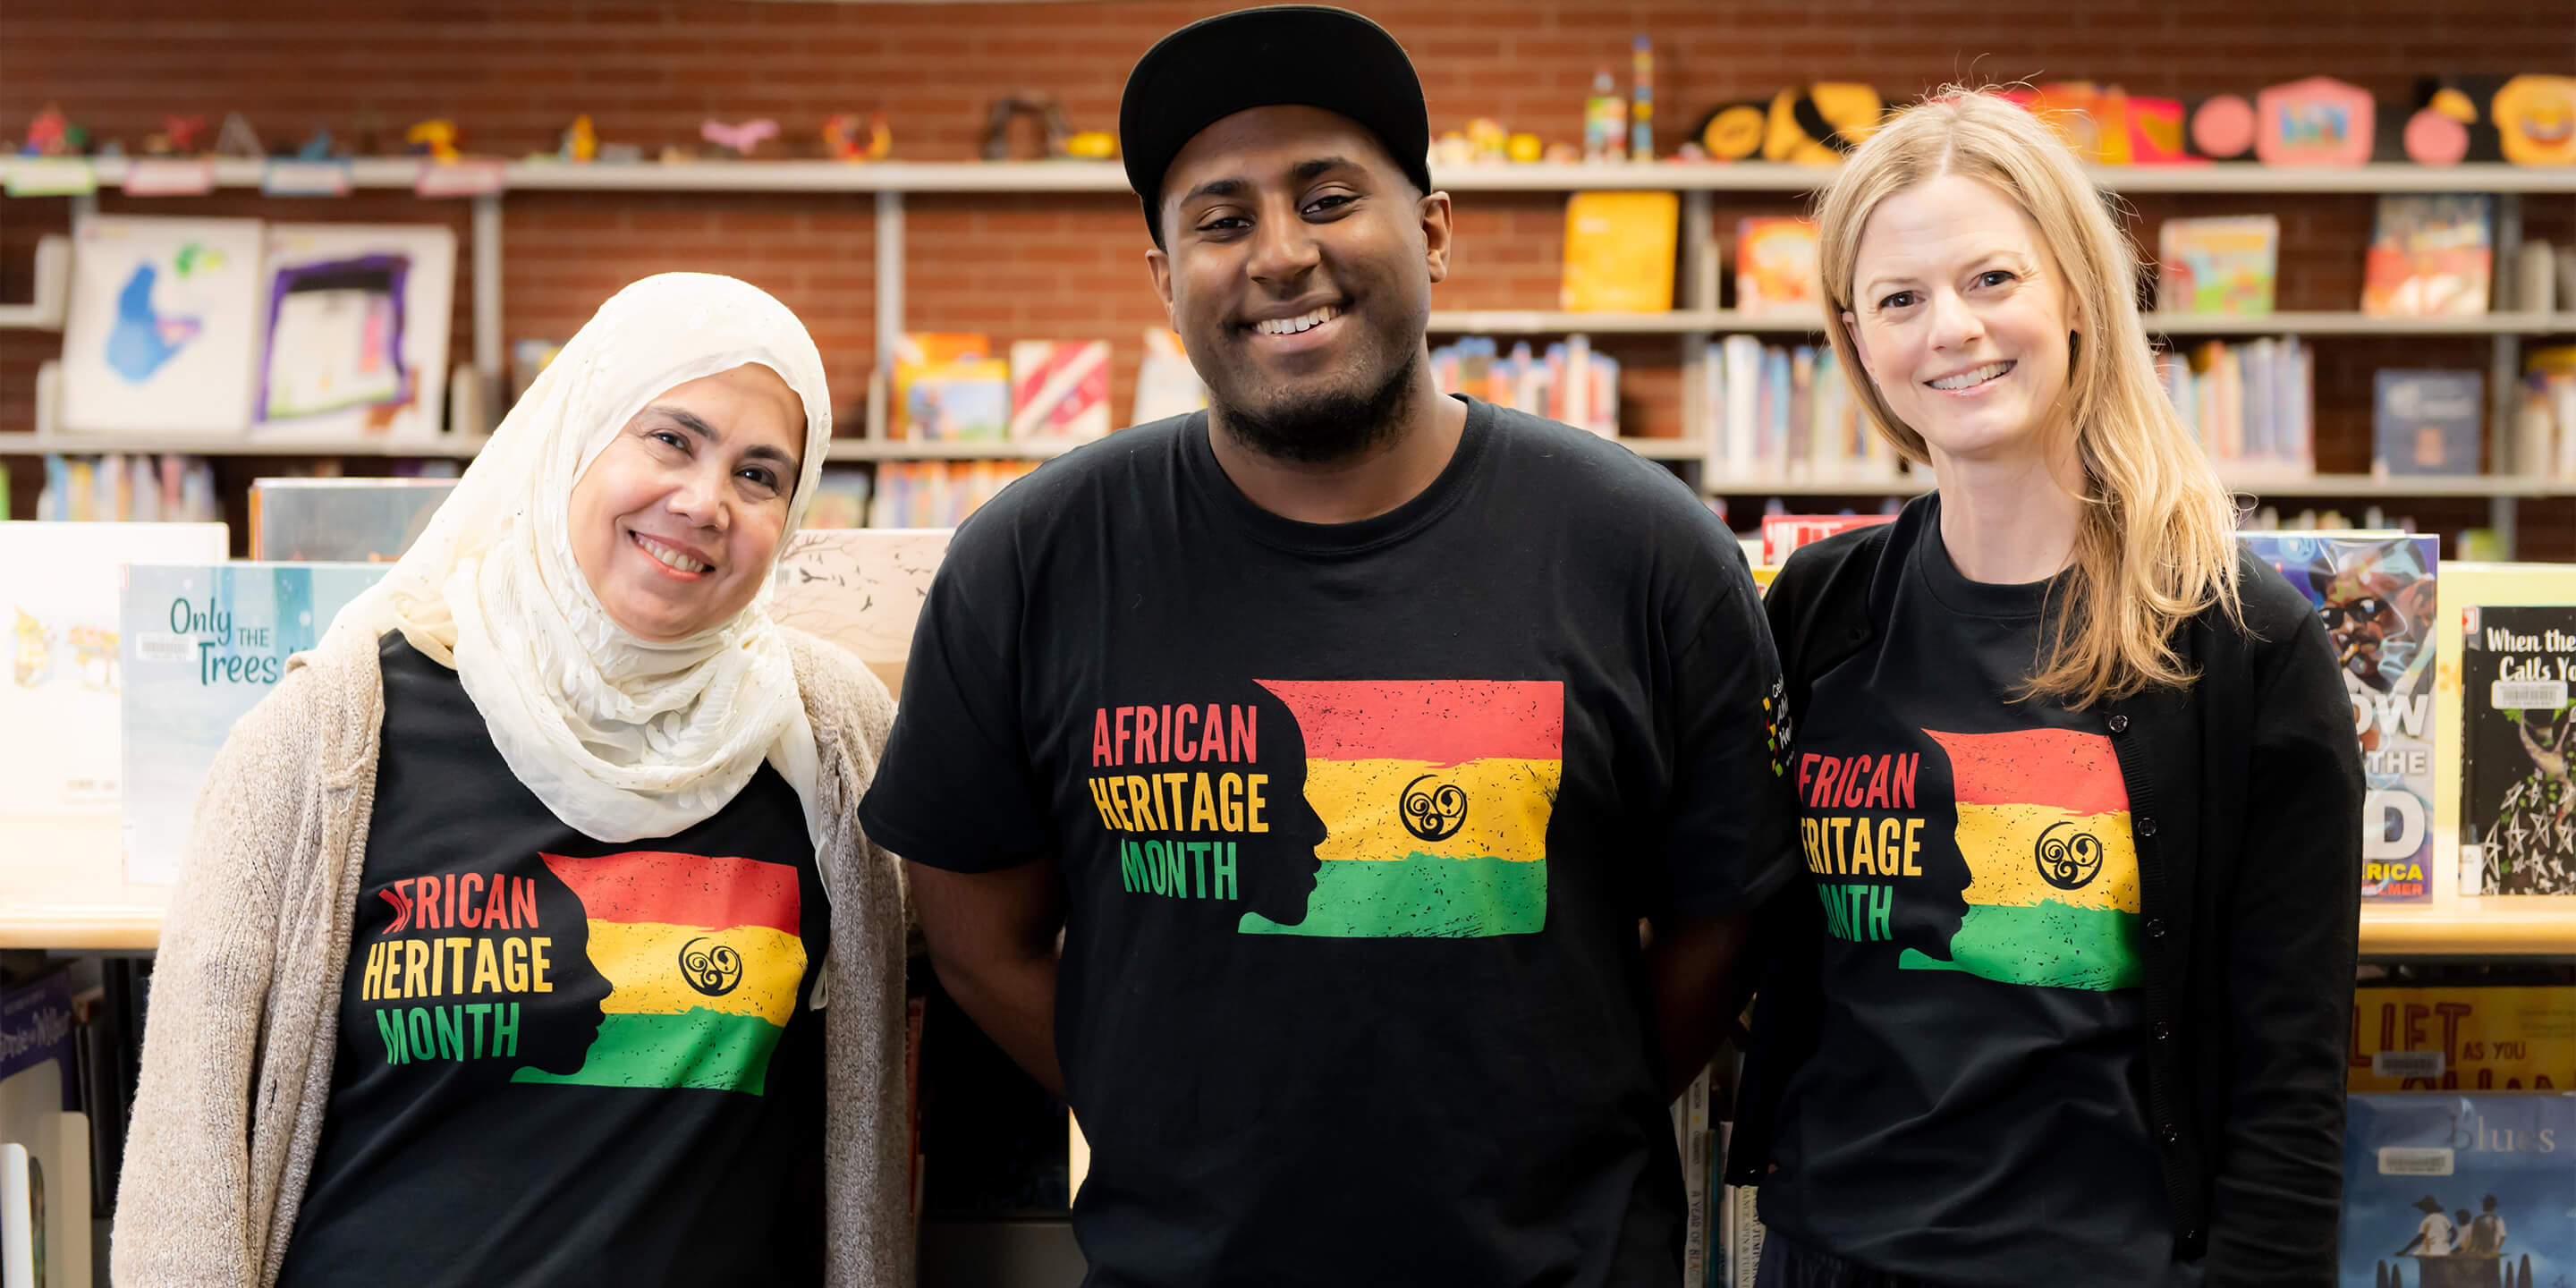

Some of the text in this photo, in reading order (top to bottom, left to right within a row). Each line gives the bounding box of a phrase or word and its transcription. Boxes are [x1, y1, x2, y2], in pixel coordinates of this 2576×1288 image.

[170, 597, 232, 646] Only
[238, 627, 270, 647] THE
[2487, 626, 2576, 652] When the
[198, 641, 278, 686] Trees
[2499, 656, 2551, 681] Calls
[1092, 703, 1258, 767] AFRICAN
[2367, 751, 2427, 774] THE
[1089, 772, 1269, 833] HERITAGE
[1797, 752, 1919, 809] FRICAN
[1121, 838, 1238, 900] MONTH
[1801, 817, 1925, 877] ERITAGE
[378, 872, 538, 935] AFRICAN
[1818, 883, 1894, 942] ONTH
[362, 936, 554, 1002] HERITAGE
[376, 1003, 520, 1065] MONTH
[2349, 1001, 2472, 1067] LIFT
[2462, 1042, 2484, 1061] AS
[2493, 1041, 2527, 1061] YOU
